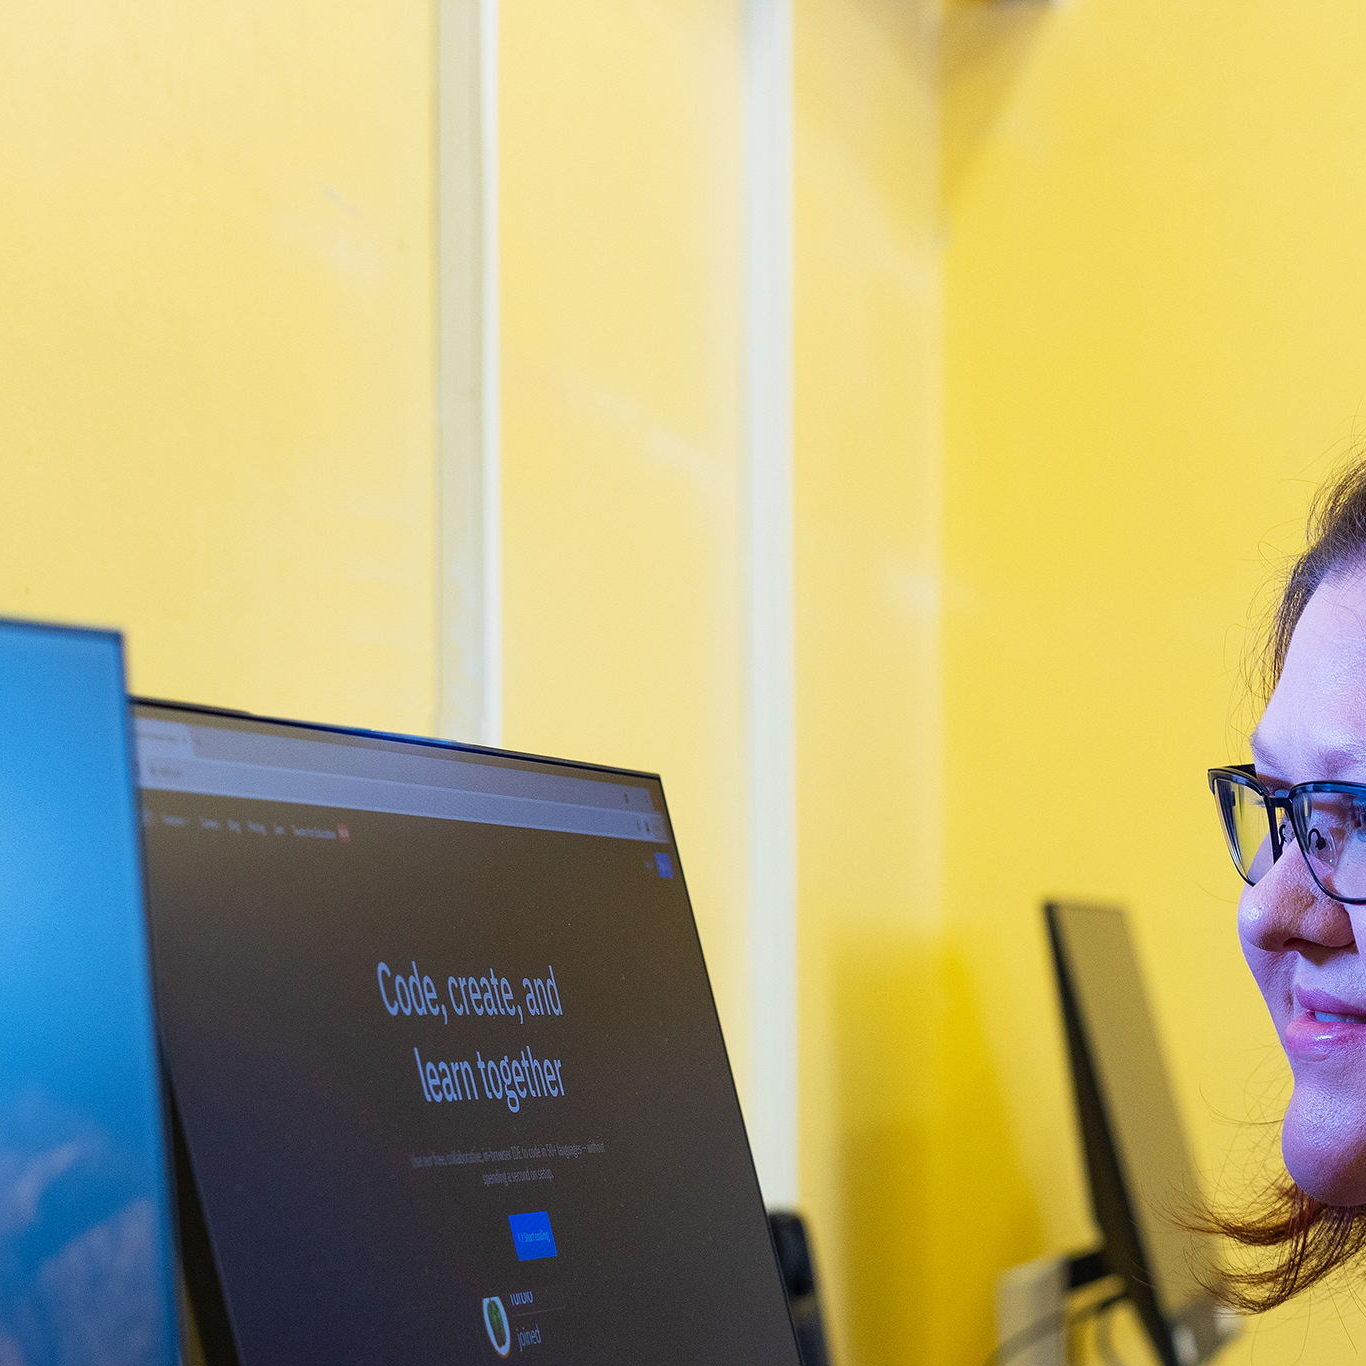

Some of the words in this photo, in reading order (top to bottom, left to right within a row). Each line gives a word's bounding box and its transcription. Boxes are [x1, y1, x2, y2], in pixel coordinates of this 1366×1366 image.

[377, 961, 448, 1025] Code,
[448, 967, 523, 1025] create,
[522, 965, 563, 1016] and
[414, 1047, 479, 1103] learn
[476, 1045, 565, 1113] together
[516, 1323, 542, 1353] joined
